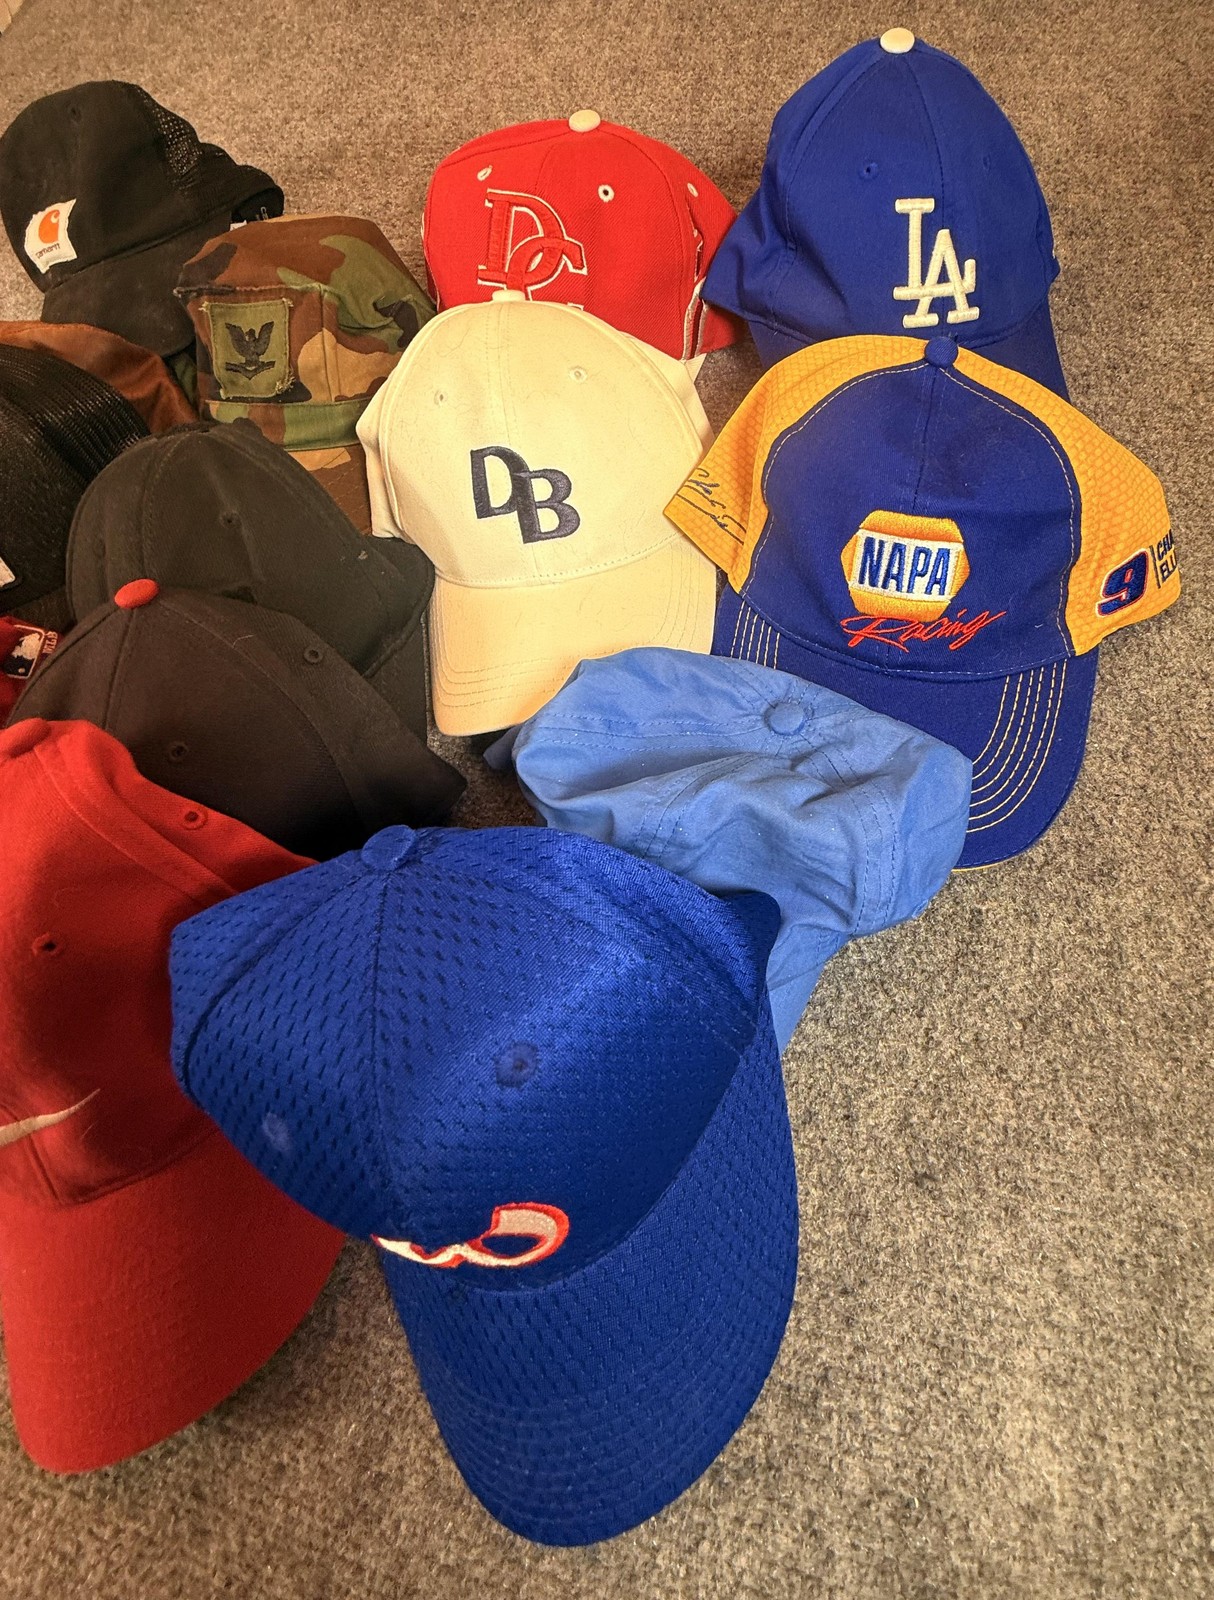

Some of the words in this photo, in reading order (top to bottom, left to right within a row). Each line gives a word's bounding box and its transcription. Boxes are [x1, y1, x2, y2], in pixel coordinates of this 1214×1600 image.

[893, 198, 980, 329] LA
[470, 446, 581, 544] DB
[858, 536, 951, 596] NAPA
[1095, 548, 1149, 617] 9
[840, 608, 1007, 653] Racing
